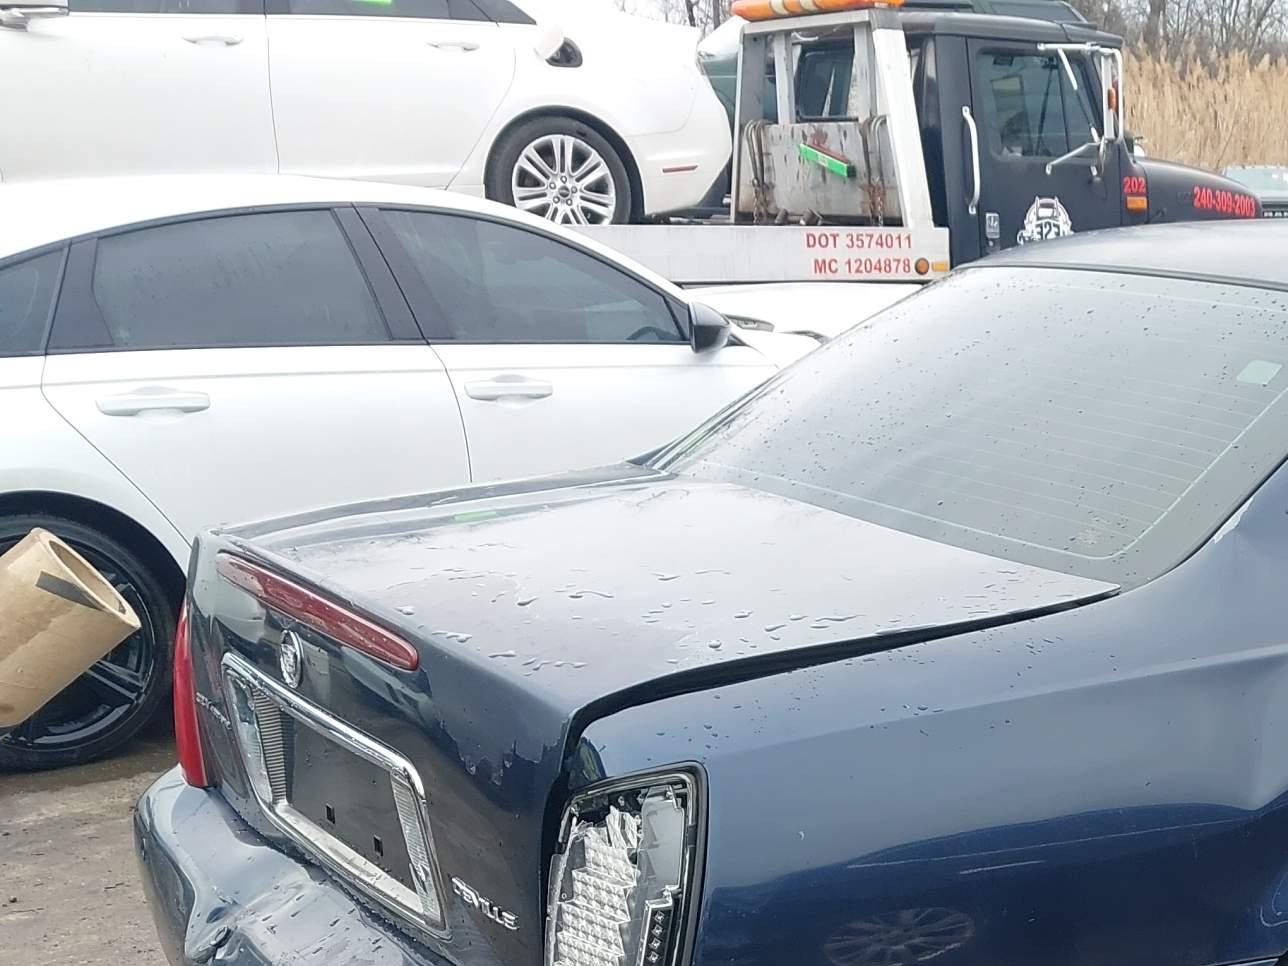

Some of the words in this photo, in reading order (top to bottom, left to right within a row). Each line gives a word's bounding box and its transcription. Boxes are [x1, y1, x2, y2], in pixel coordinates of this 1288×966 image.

[1123, 176, 1146, 193] 202
[806, 233, 839, 248] DOT
[846, 232, 912, 249] 3574011
[814, 258, 839, 274] MC
[845, 257, 911, 275] 1204878
